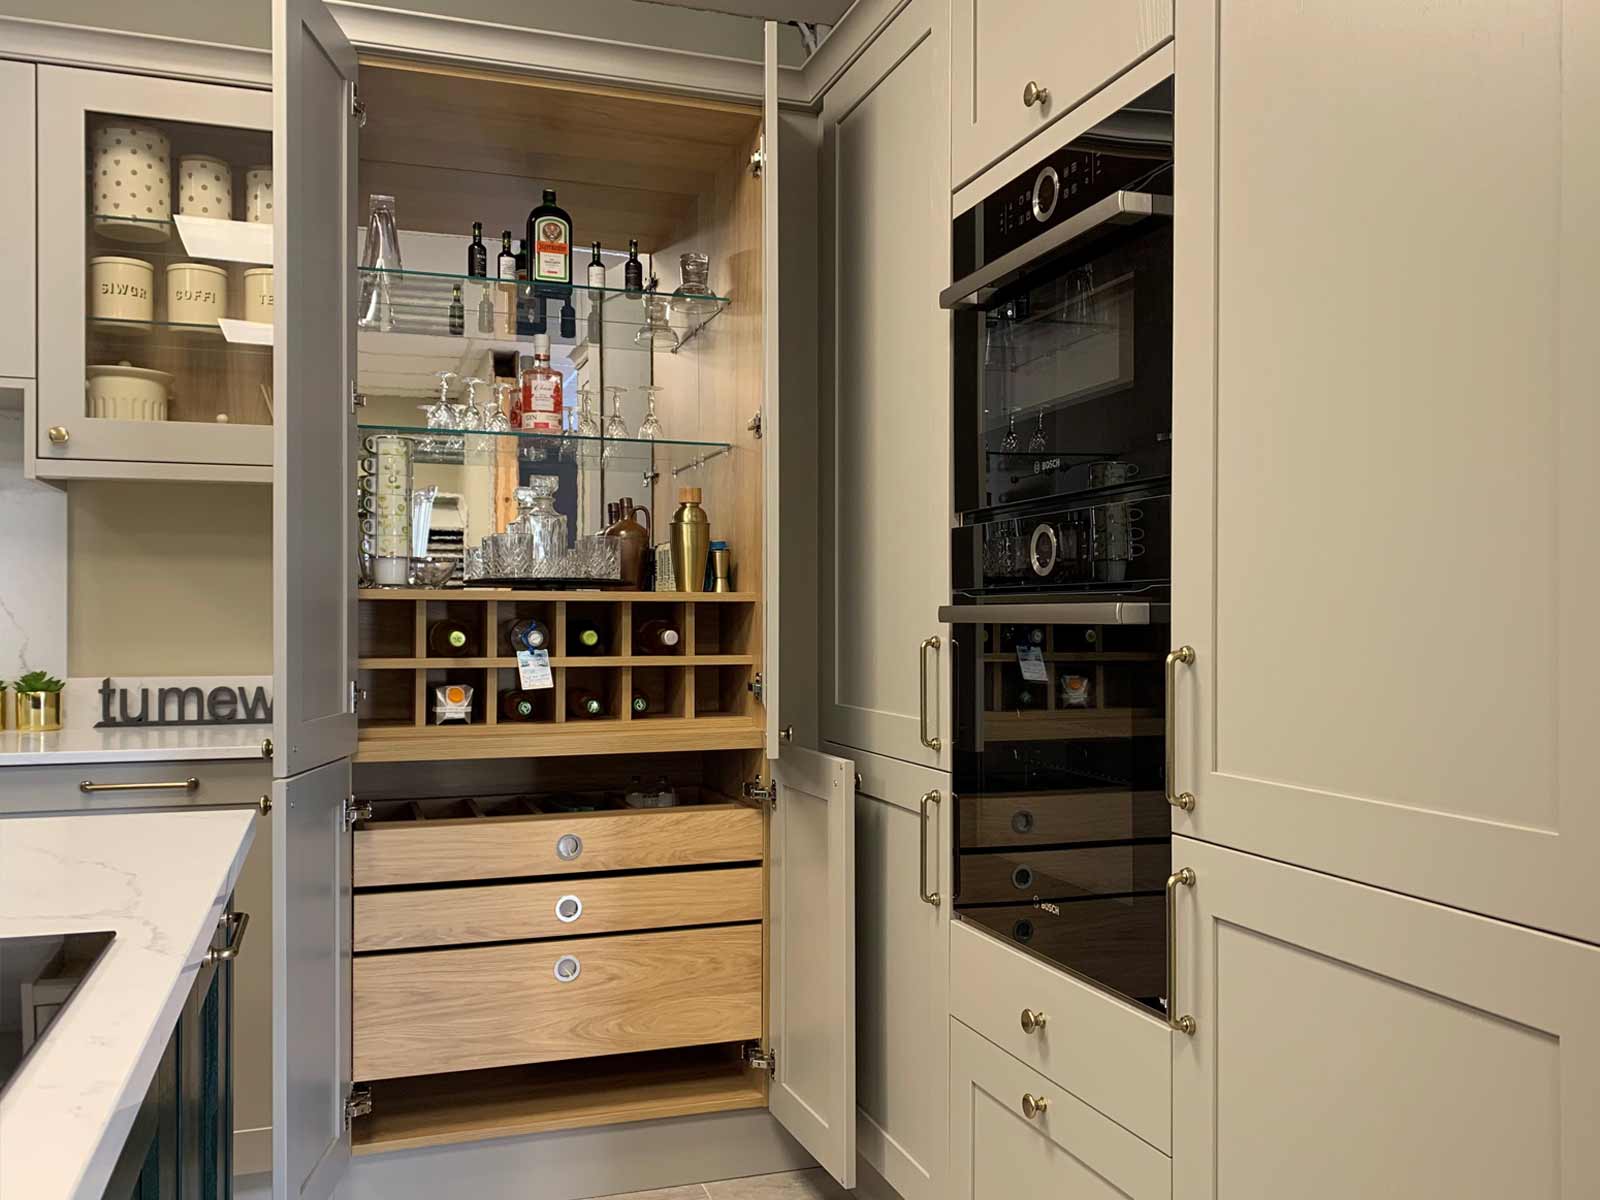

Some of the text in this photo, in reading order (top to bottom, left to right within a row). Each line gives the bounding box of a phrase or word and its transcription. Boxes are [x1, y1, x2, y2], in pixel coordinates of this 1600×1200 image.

[101, 281, 147, 299] SIWGR
[175, 290, 216, 304] COFFI
[1041, 457, 1061, 471] BOSCH
